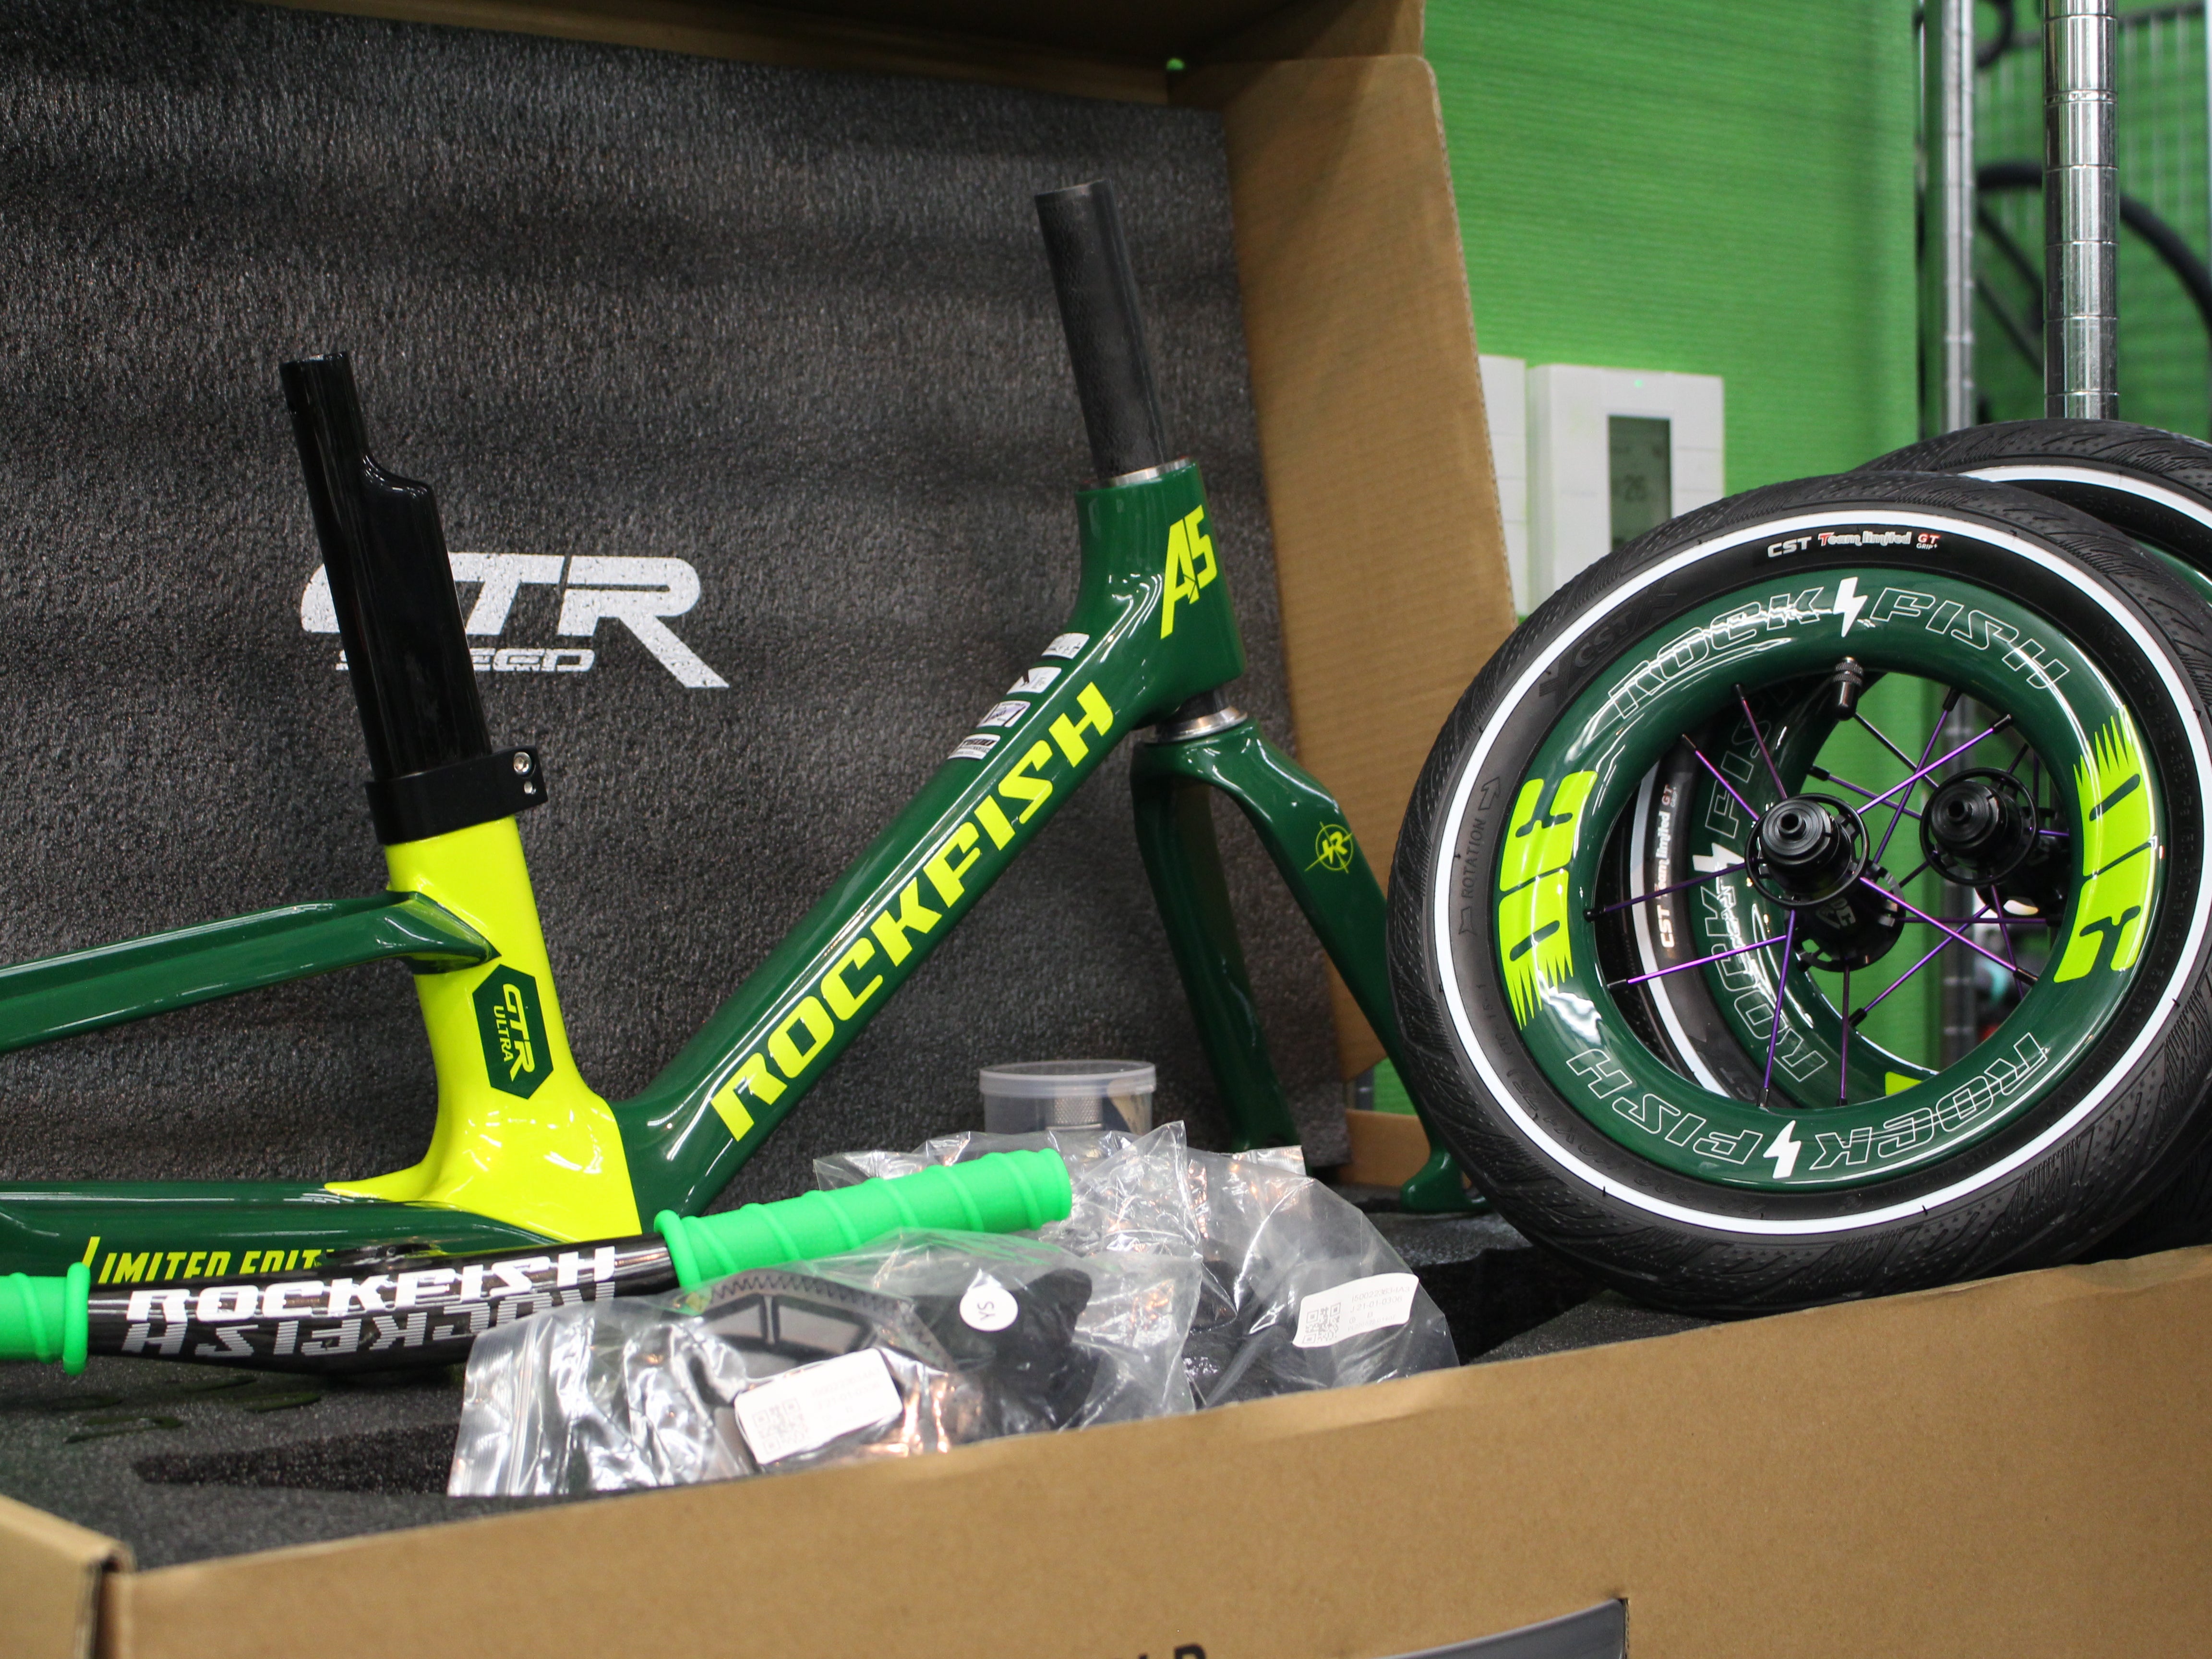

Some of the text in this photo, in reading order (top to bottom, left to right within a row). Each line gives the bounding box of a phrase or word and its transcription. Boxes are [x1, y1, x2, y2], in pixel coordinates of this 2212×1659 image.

[1160, 505, 1218, 639] A5
[1767, 530, 1941, 558] CST Team limited GT
[1608, 586, 1824, 720] ROCK
[1869, 587, 2070, 690] FISH
[1461, 817, 1486, 898] ROTATION
[710, 682, 1114, 1142] ROCKFISH
[1657, 904, 1675, 949] CST
[493, 1005, 514, 1062] ULTRA
[503, 983, 536, 1082] GTR
[1700, 886, 1828, 1082] ROCK
[1565, 1048, 1764, 1165] FISH
[1808, 1032, 2048, 1171] ROCK
[126, 1246, 616, 1322] ROCKFISH
